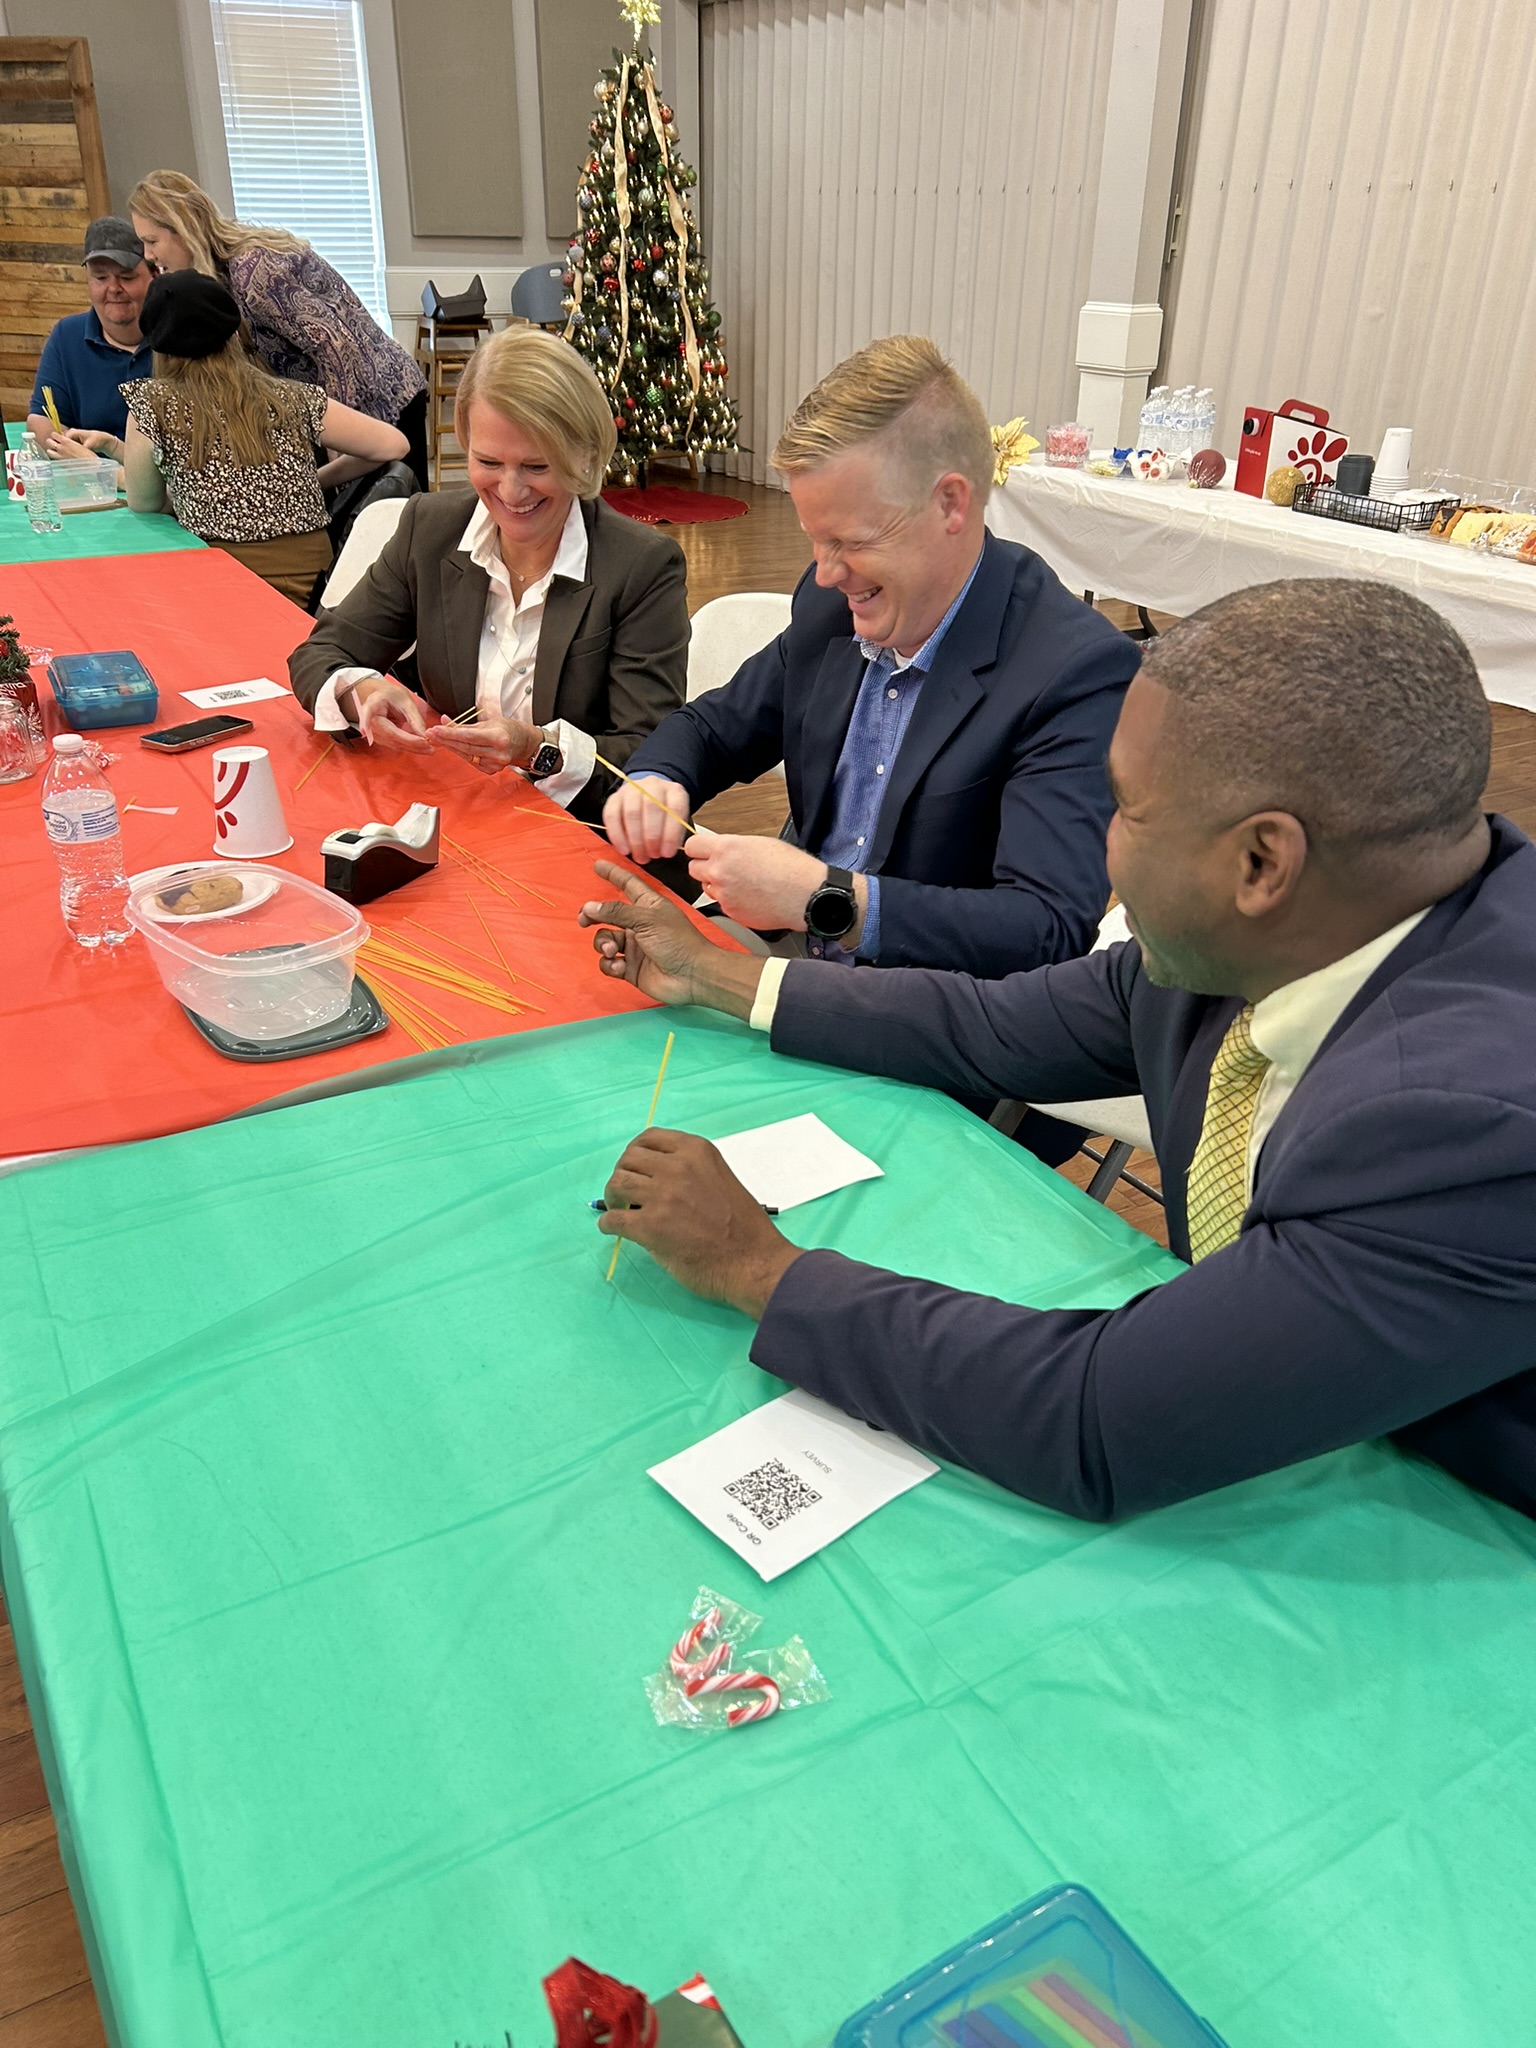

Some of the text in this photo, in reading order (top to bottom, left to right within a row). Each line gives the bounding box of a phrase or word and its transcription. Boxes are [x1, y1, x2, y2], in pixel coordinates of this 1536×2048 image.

[801, 1450, 832, 1473] SURVEY
[726, 1513, 762, 1545] QR Code
